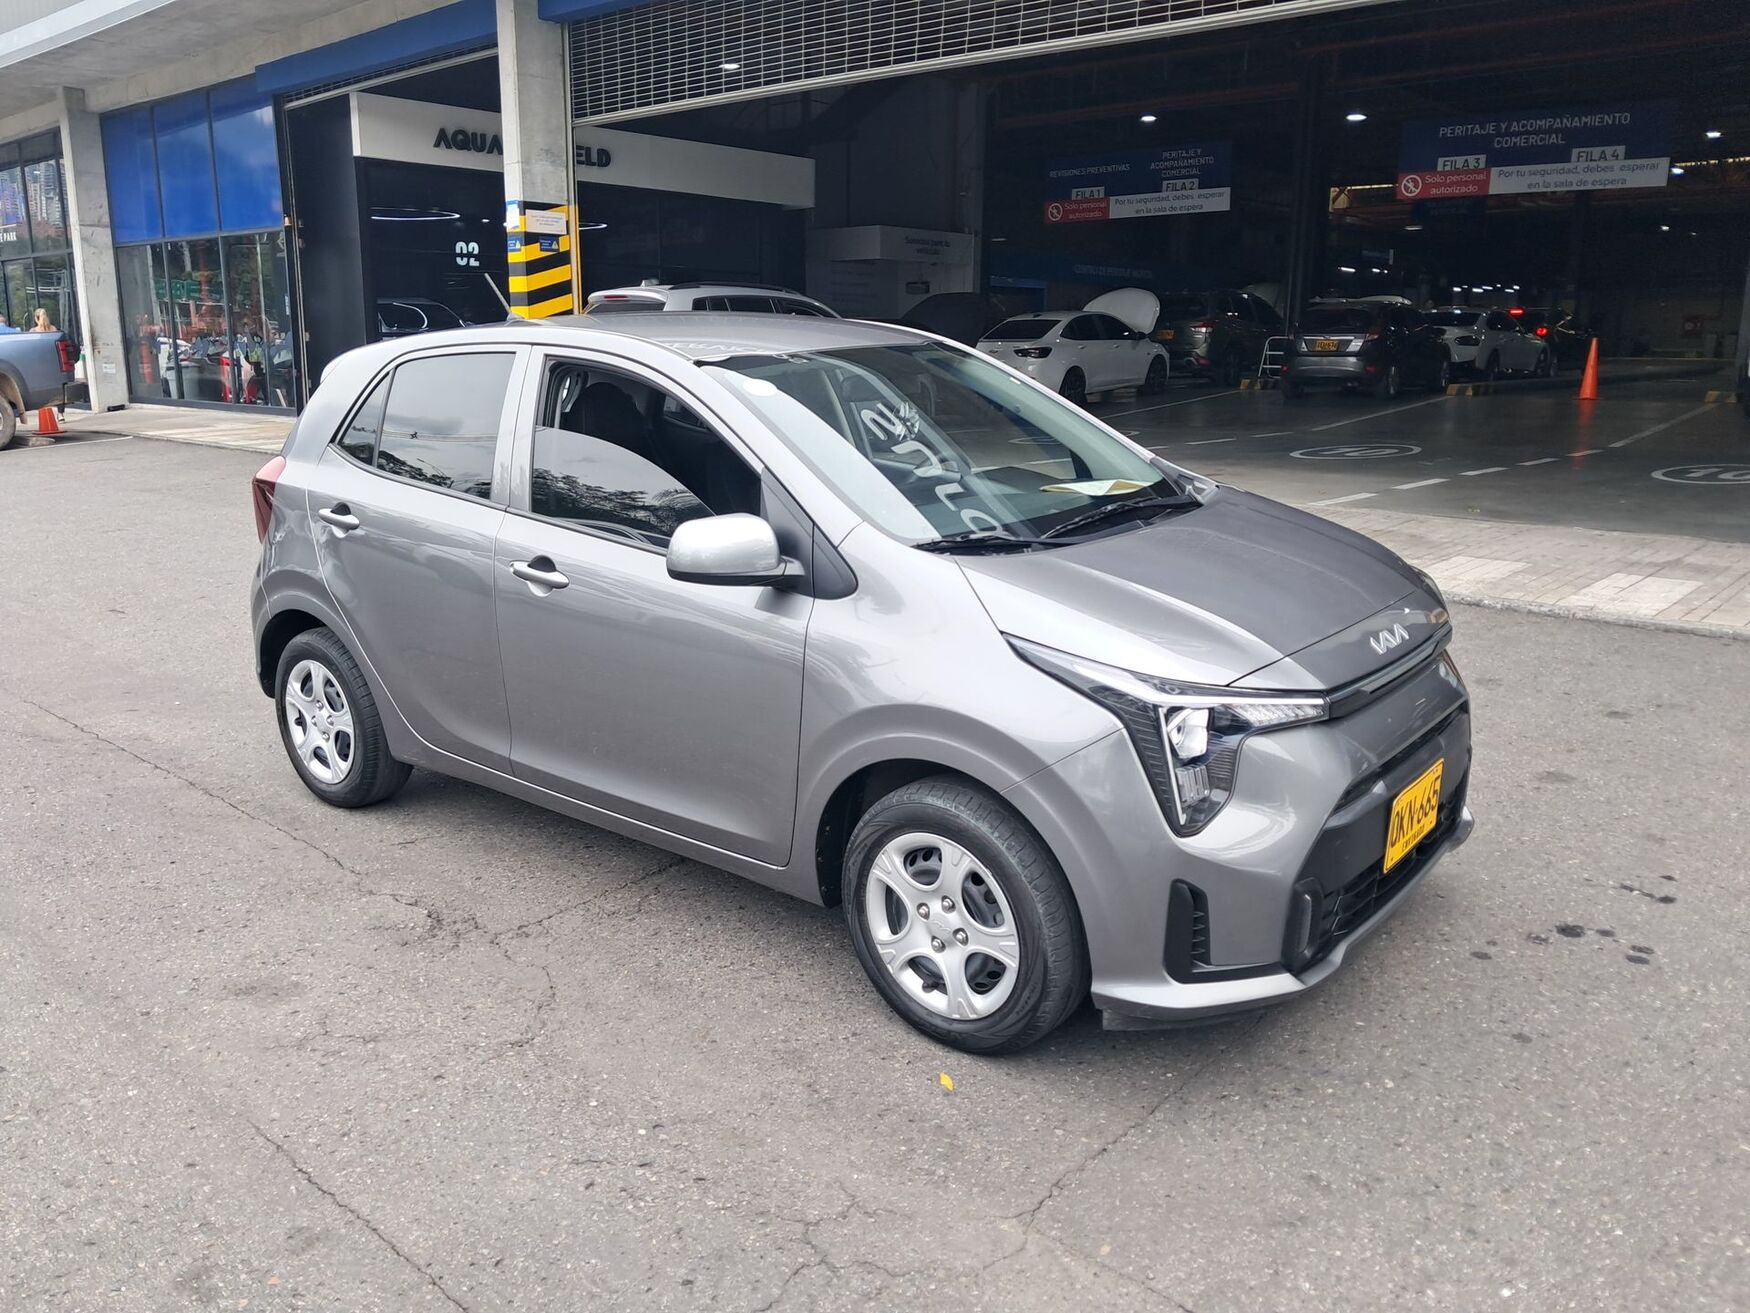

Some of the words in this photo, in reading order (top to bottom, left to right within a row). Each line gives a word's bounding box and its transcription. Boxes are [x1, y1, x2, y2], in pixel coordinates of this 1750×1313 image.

[1439, 124, 1498, 137] PERITAJE
[1500, 122, 1509, 133] Y
[1510, 112, 1631, 132] ACOMPAÑAMIENTO
[433, 127, 503, 155] AQUA
[1494, 133, 1566, 148] COMERCIAL
[1163, 149, 1196, 159] PERITAJE
[1577, 150, 1608, 162] FILA
[1610, 149, 1620, 160] 4
[1442, 159, 1470, 170] FILA
[1472, 157, 1481, 168] 3
[1162, 167, 1201, 177] COMERCIAL
[1425, 174, 1442, 183] Solo
[1443, 172, 1487, 184] personal
[1498, 169, 1514, 178] Por
[1515, 169, 1526, 177] tu
[1166, 181, 1187, 192] FILA
[1189, 181, 1195, 190] 2
[1430, 183, 1479, 195] autorizado
[1527, 181, 1540, 189] en
[1541, 179, 1551, 188] la
[1553, 179, 1574, 188] sala
[1576, 178, 1589, 187] de
[1591, 178, 1627, 188] espera
[1075, 189, 1095, 199] FILA
[455, 240, 480, 267] 02
